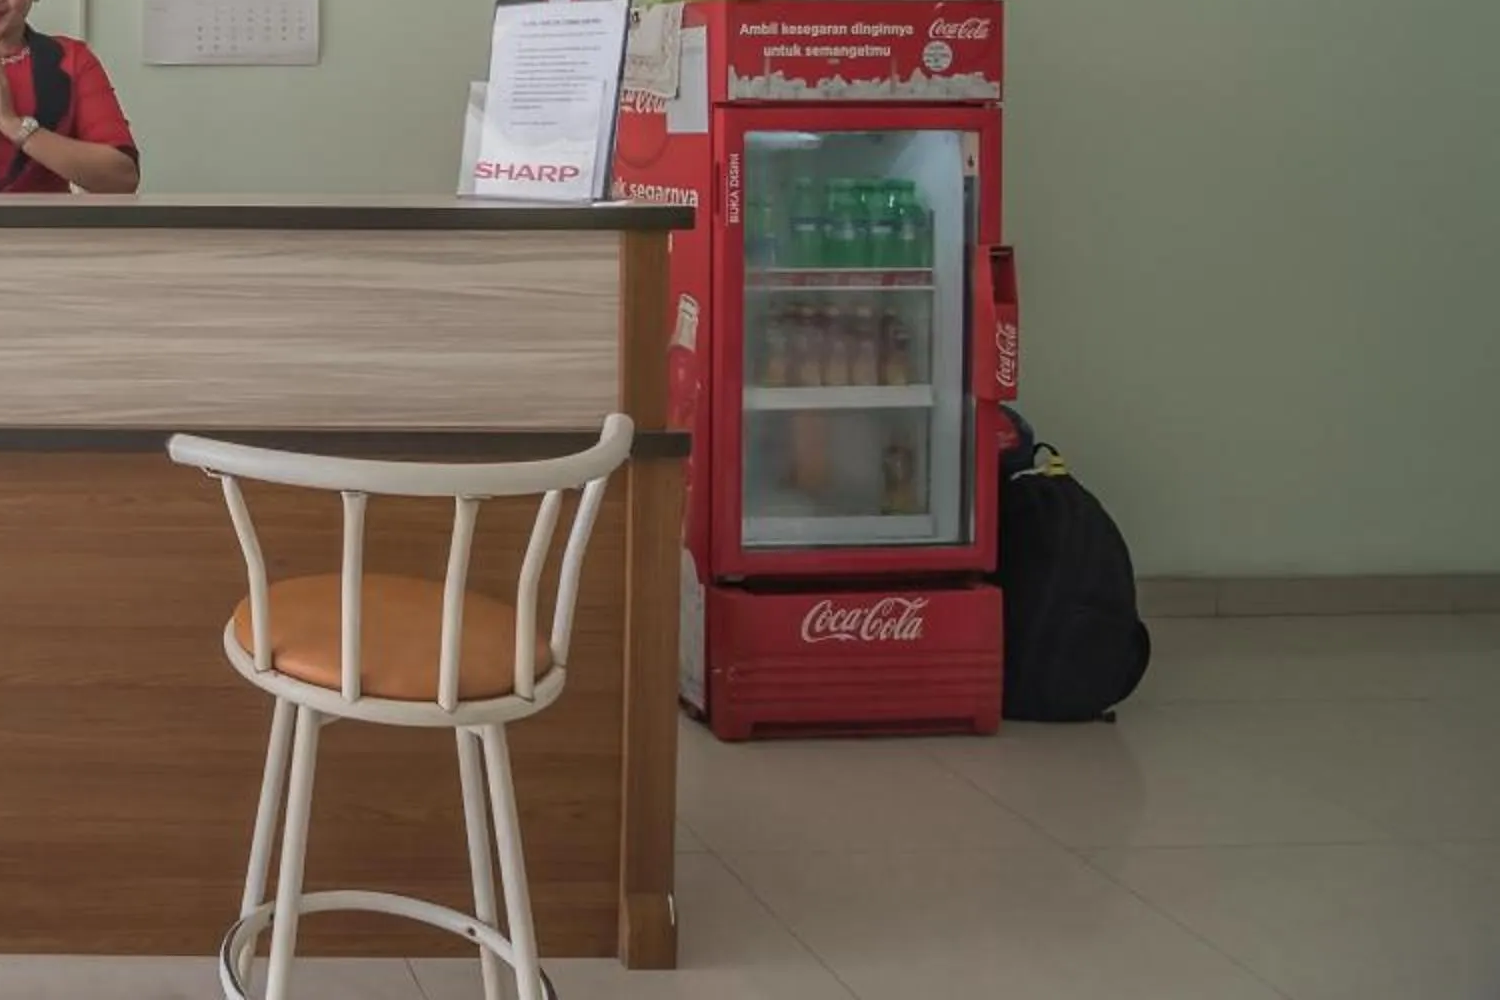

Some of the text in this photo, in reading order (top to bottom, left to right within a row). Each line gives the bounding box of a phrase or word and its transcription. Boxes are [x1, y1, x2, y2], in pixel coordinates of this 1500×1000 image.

[739, 23, 914, 37] Ambil kesegaran dinginnya
[763, 44, 891, 58] untuk semangatmu
[473, 161, 580, 183] SHARP
[801, 597, 929, 643] Coca-Cola
